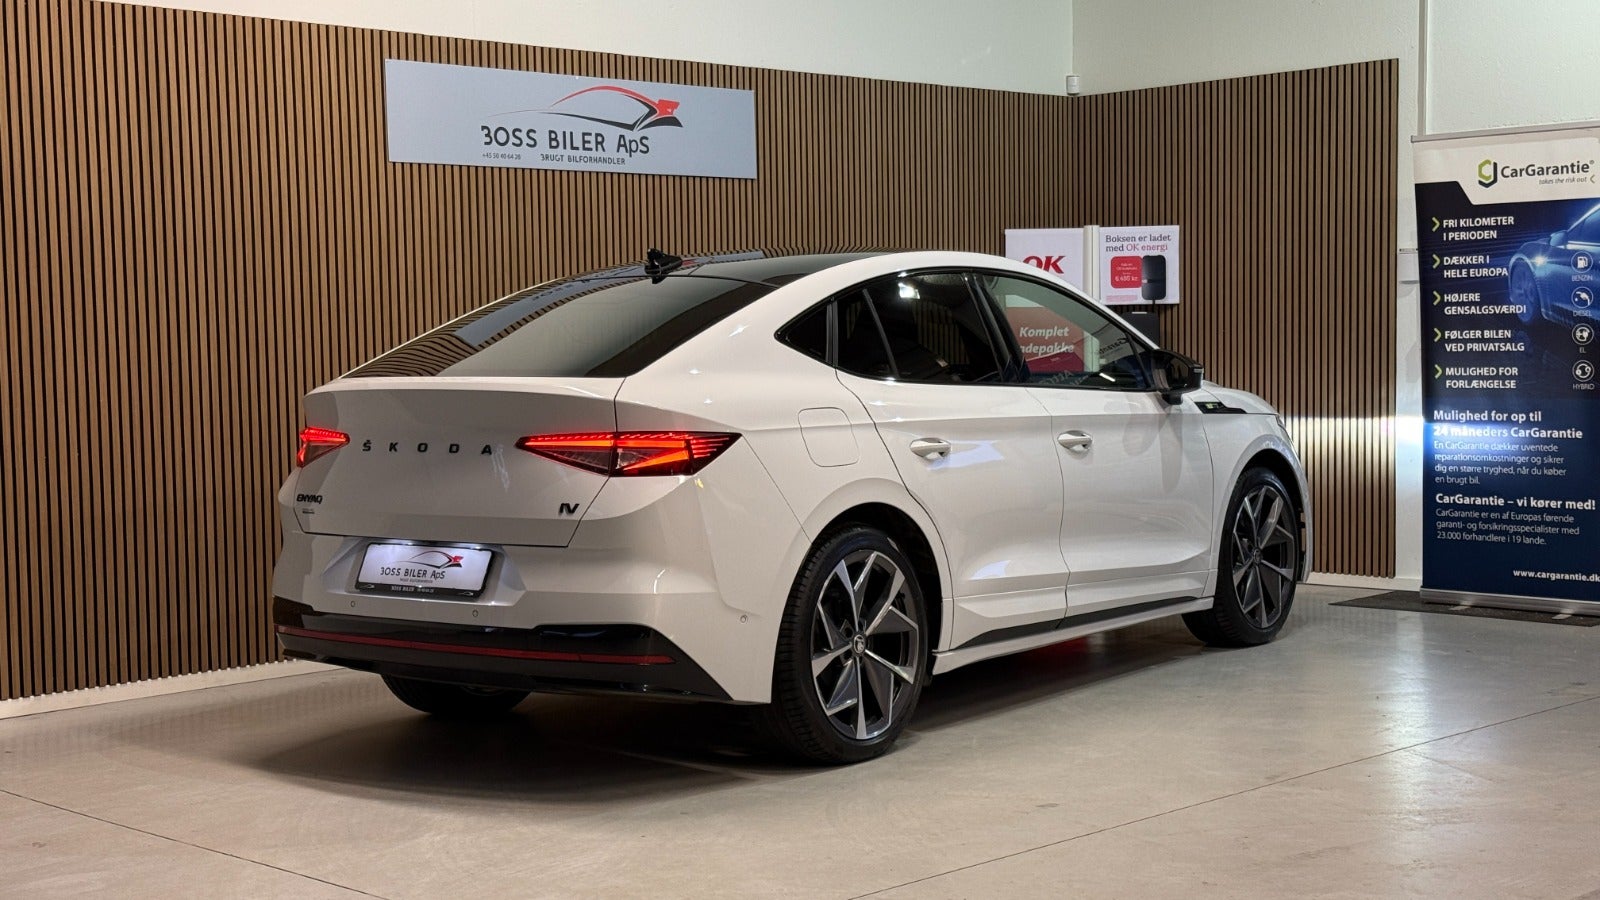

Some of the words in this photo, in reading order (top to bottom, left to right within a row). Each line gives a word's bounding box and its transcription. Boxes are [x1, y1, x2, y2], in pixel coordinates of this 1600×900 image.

[548, 129, 606, 152] BILER
[616, 134, 650, 157] ApS
[567, 155, 626, 165] BILFORHANDLER
[1443, 219, 1457, 228] FRI
[1460, 216, 1514, 227] KILOMETER
[1150, 234, 1172, 242] ladet
[1443, 233, 1446, 241] I
[1448, 230, 1497, 241] PERIODEN
[1106, 244, 1124, 252] med
[1126, 243, 1140, 251] OK
[1141, 244, 1168, 252] energi
[1023, 256, 1066, 274] OK
[1444, 255, 1484, 265] DÆKKER
[1487, 255, 1490, 264] I
[1444, 269, 1467, 278] HELE
[1470, 267, 1508, 277] EUROPA
[1444, 293, 1480, 302] HØJERE
[1444, 305, 1527, 315] GENSALGSVÆRDI
[1020, 326, 1069, 339] Komplet
[1445, 330, 1482, 339] FØLGER
[1484, 330, 1511, 338] BILEN
[1020, 342, 1074, 357] adepakke
[1445, 343, 1464, 352] VED
[1467, 342, 1525, 352] PRIVATSALG
[1446, 367, 1496, 376] MULIGHED
[1499, 367, 1518, 375] FOR
[1446, 380, 1516, 389] FORLÆNGELSE
[1434, 410, 1488, 423] Mulighed
[1491, 411, 1508, 421] for
[1511, 413, 1526, 423] op
[1529, 411, 1542, 421] til
[1433, 426, 1448, 436] 24
[1450, 426, 1508, 437] måneders
[1511, 427, 1583, 439] CarGarantie
[362, 440, 492, 455] ŠKODA
[1434, 441, 1444, 449] En
[1445, 441, 1490, 450] CarGarantie
[1491, 443, 1519, 451] dækker
[1521, 444, 1558, 452] uventede
[1435, 453, 1529, 465] reparationsomkostninger
[1531, 456, 1542, 465] og
[1543, 455, 1564, 464] sikrer
[1435, 464, 1447, 473] dig
[1460, 465, 1482, 473] større
[1483, 465, 1515, 476] tryghed,
[1517, 466, 1529, 475] når
[1531, 467, 1542, 475] du
[1543, 467, 1566, 476] køber
[1446, 475, 1467, 485] brugt
[1469, 475, 1480, 484] bil.
[297, 494, 323, 504] ENYAQ
[1436, 493, 1505, 506] CarGarantie
[1517, 497, 1527, 507] vi
[1530, 497, 1562, 509] kører
[1565, 499, 1596, 510] med!
[1436, 508, 1480, 518] CarGarantie
[1490, 511, 1500, 519] en
[1502, 511, 1509, 520] af
[1511, 512, 1542, 522] Europas
[1543, 514, 1574, 523] førende
[1436, 520, 1465, 530] garanti-
[1466, 524, 1477, 532] og
[1478, 522, 1559, 534] forsikringsspecialister
[1561, 527, 1580, 535] med
[1437, 531, 1462, 540] 23.000
[1463, 532, 1506, 543] forhandlere
[1512, 535, 1521, 543] 19
[1523, 535, 1546, 545] lande.
[404, 568, 427, 578] BILER
[430, 570, 446, 580] ApS
[1513, 569, 1600, 583] www.cargarantie.dk
